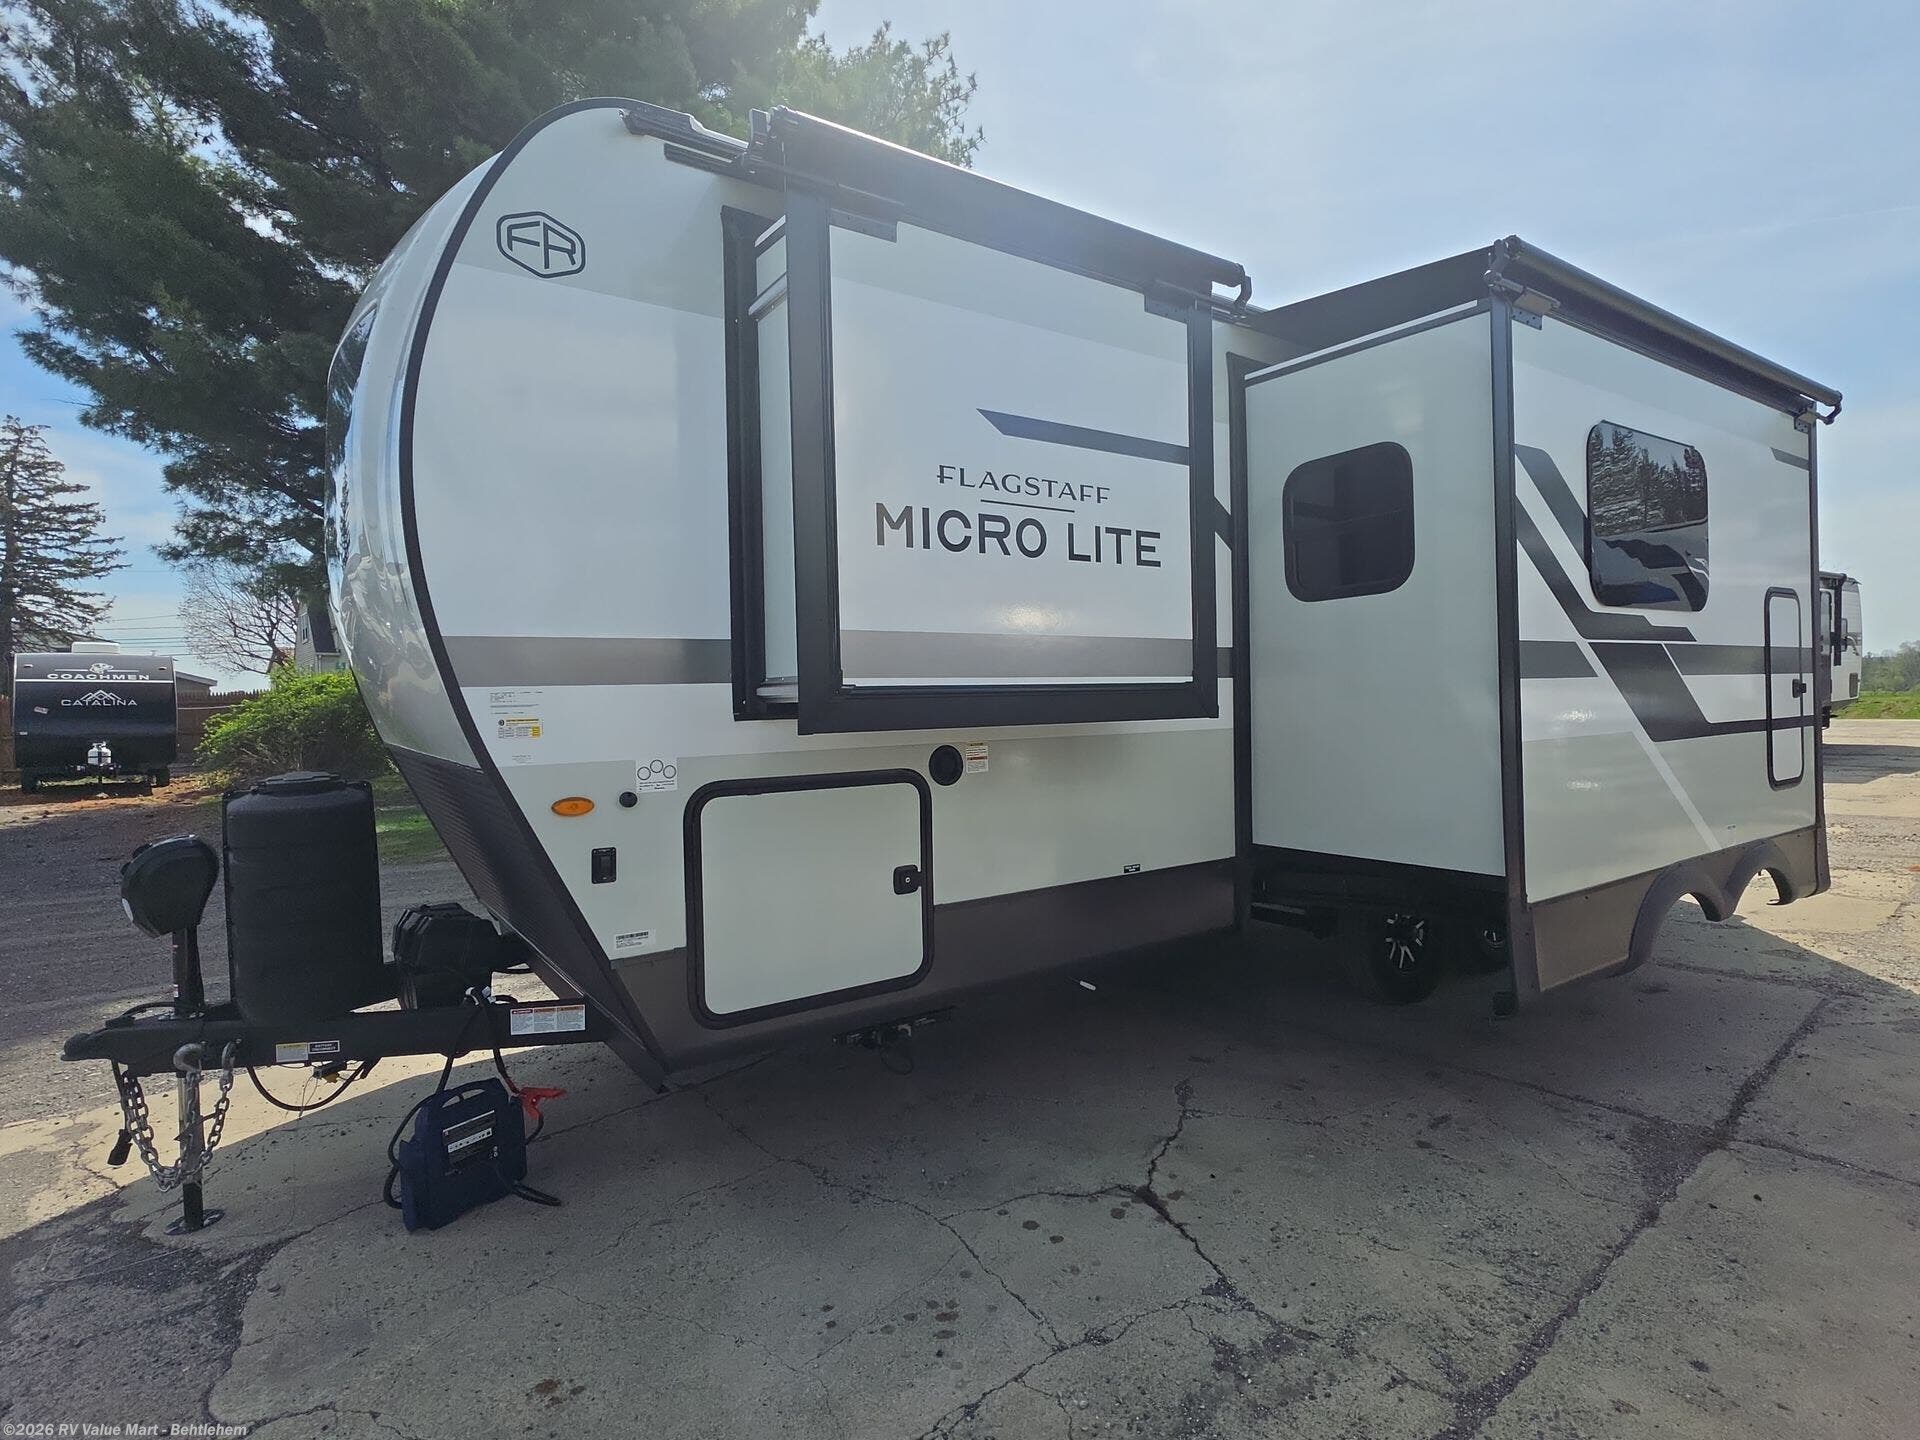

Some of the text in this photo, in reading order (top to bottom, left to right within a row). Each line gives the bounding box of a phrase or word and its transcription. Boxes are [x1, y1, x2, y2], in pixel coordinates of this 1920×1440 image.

[937, 464, 1110, 504] FLAGSTAFF
[875, 502, 1162, 568] MICRO LITE
